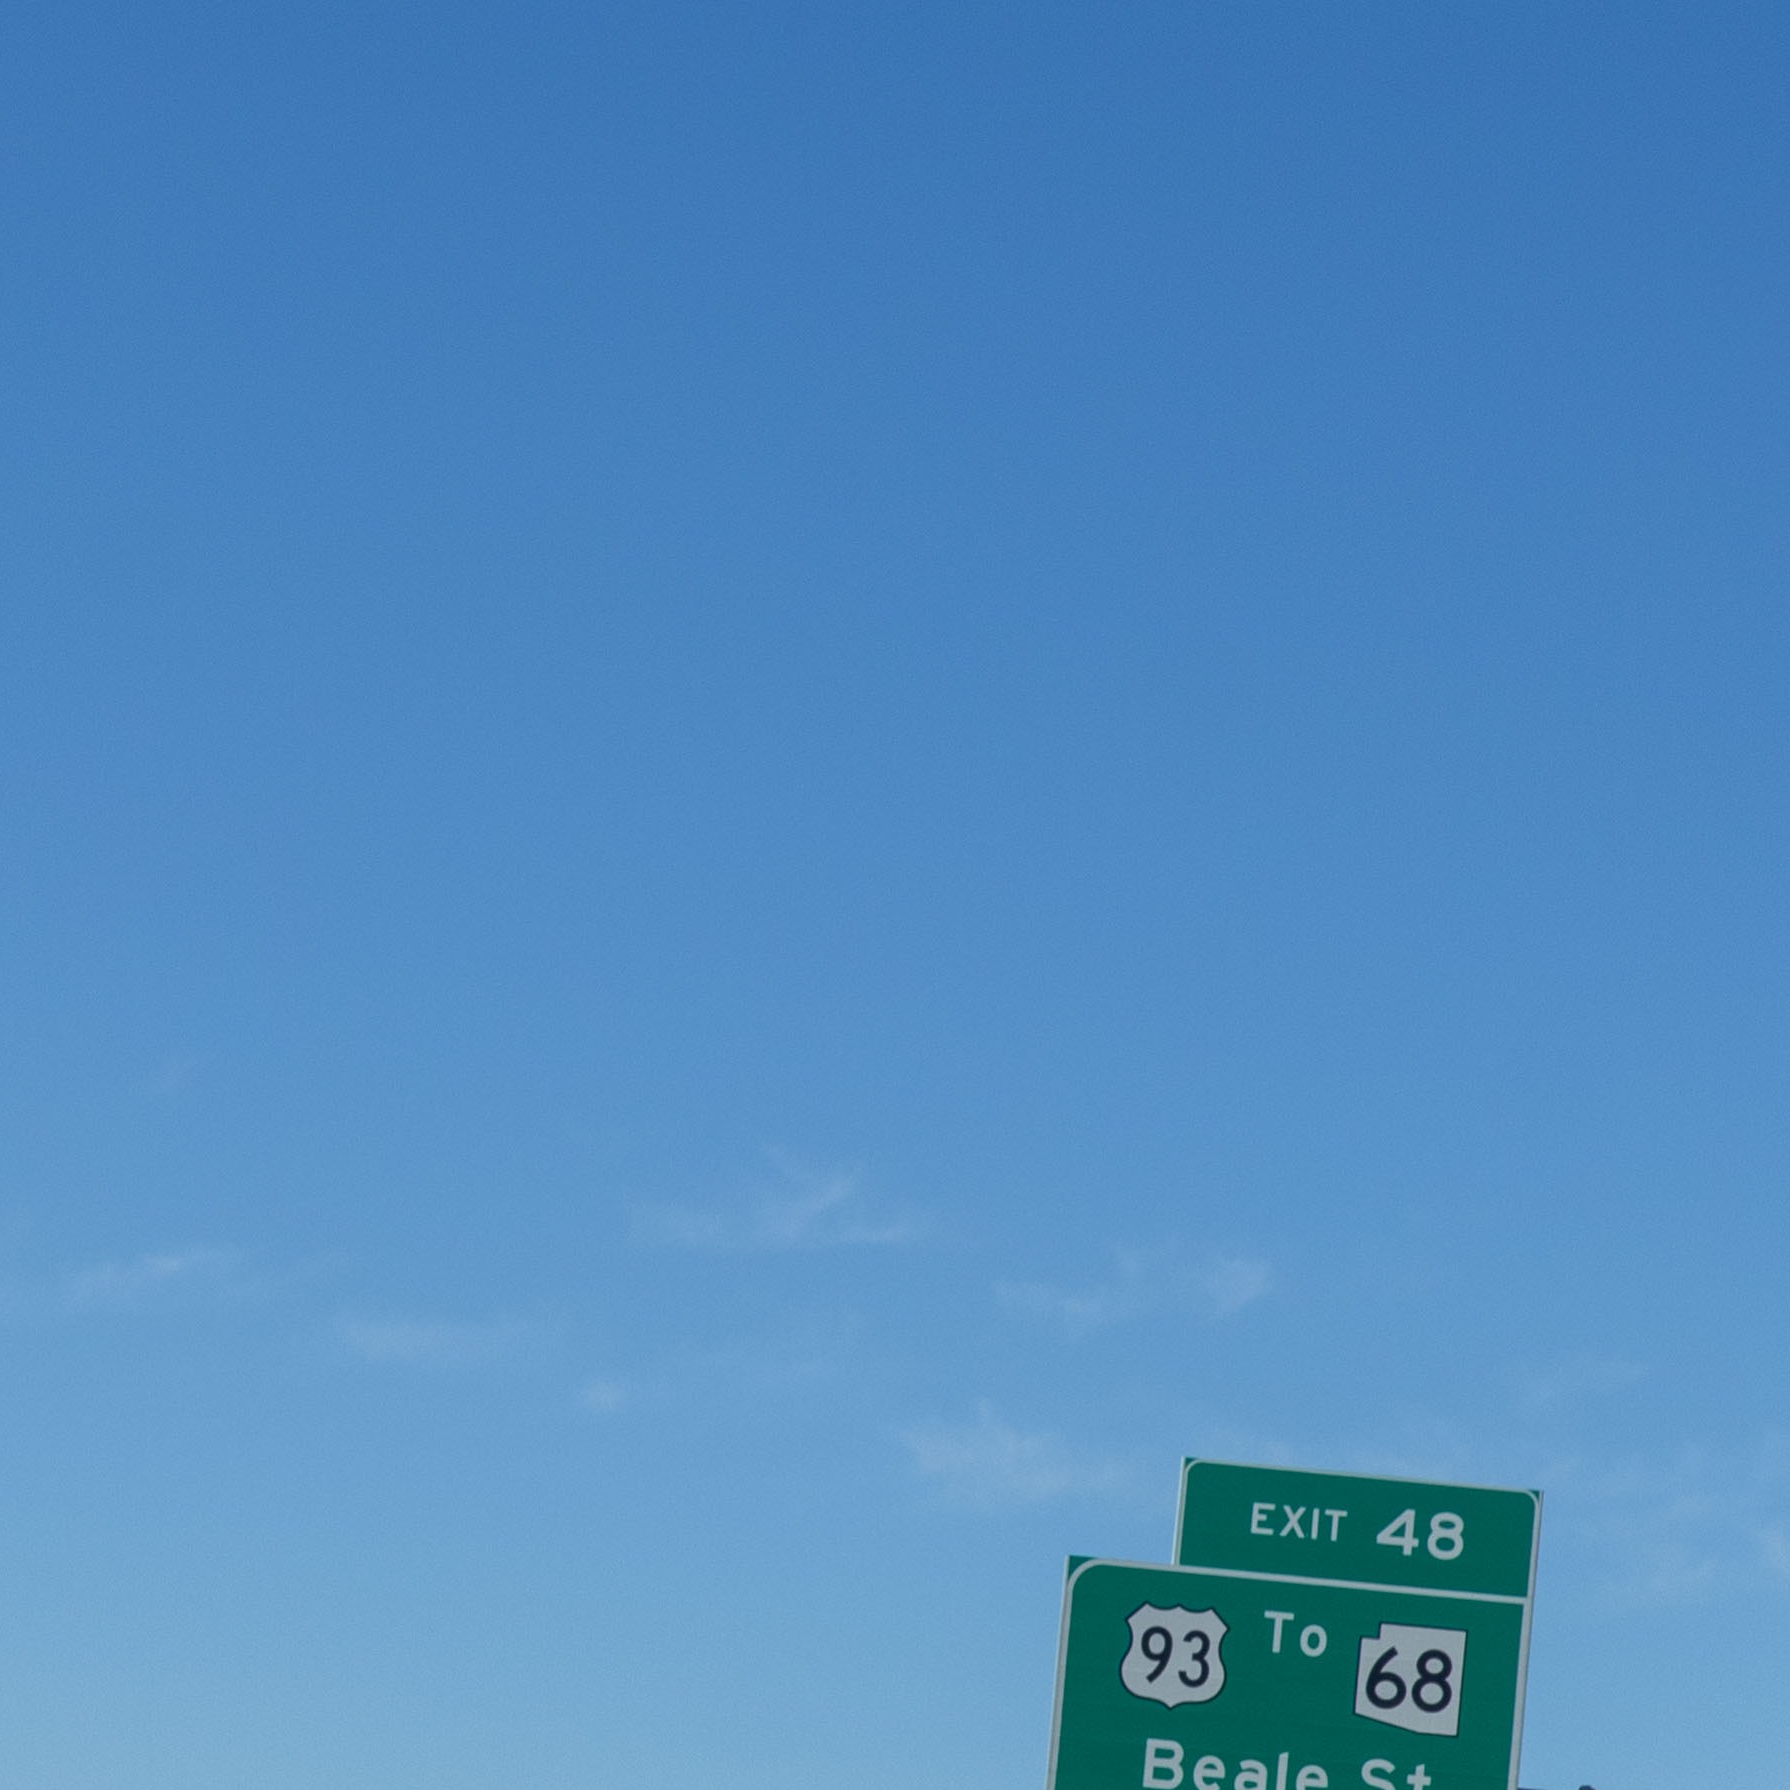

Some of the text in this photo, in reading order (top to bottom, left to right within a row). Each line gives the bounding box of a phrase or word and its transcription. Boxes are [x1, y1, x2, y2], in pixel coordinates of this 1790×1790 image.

[1249, 1502, 1464, 1560] EXIT 48
[1140, 1610, 1453, 1713] 93 To 68
